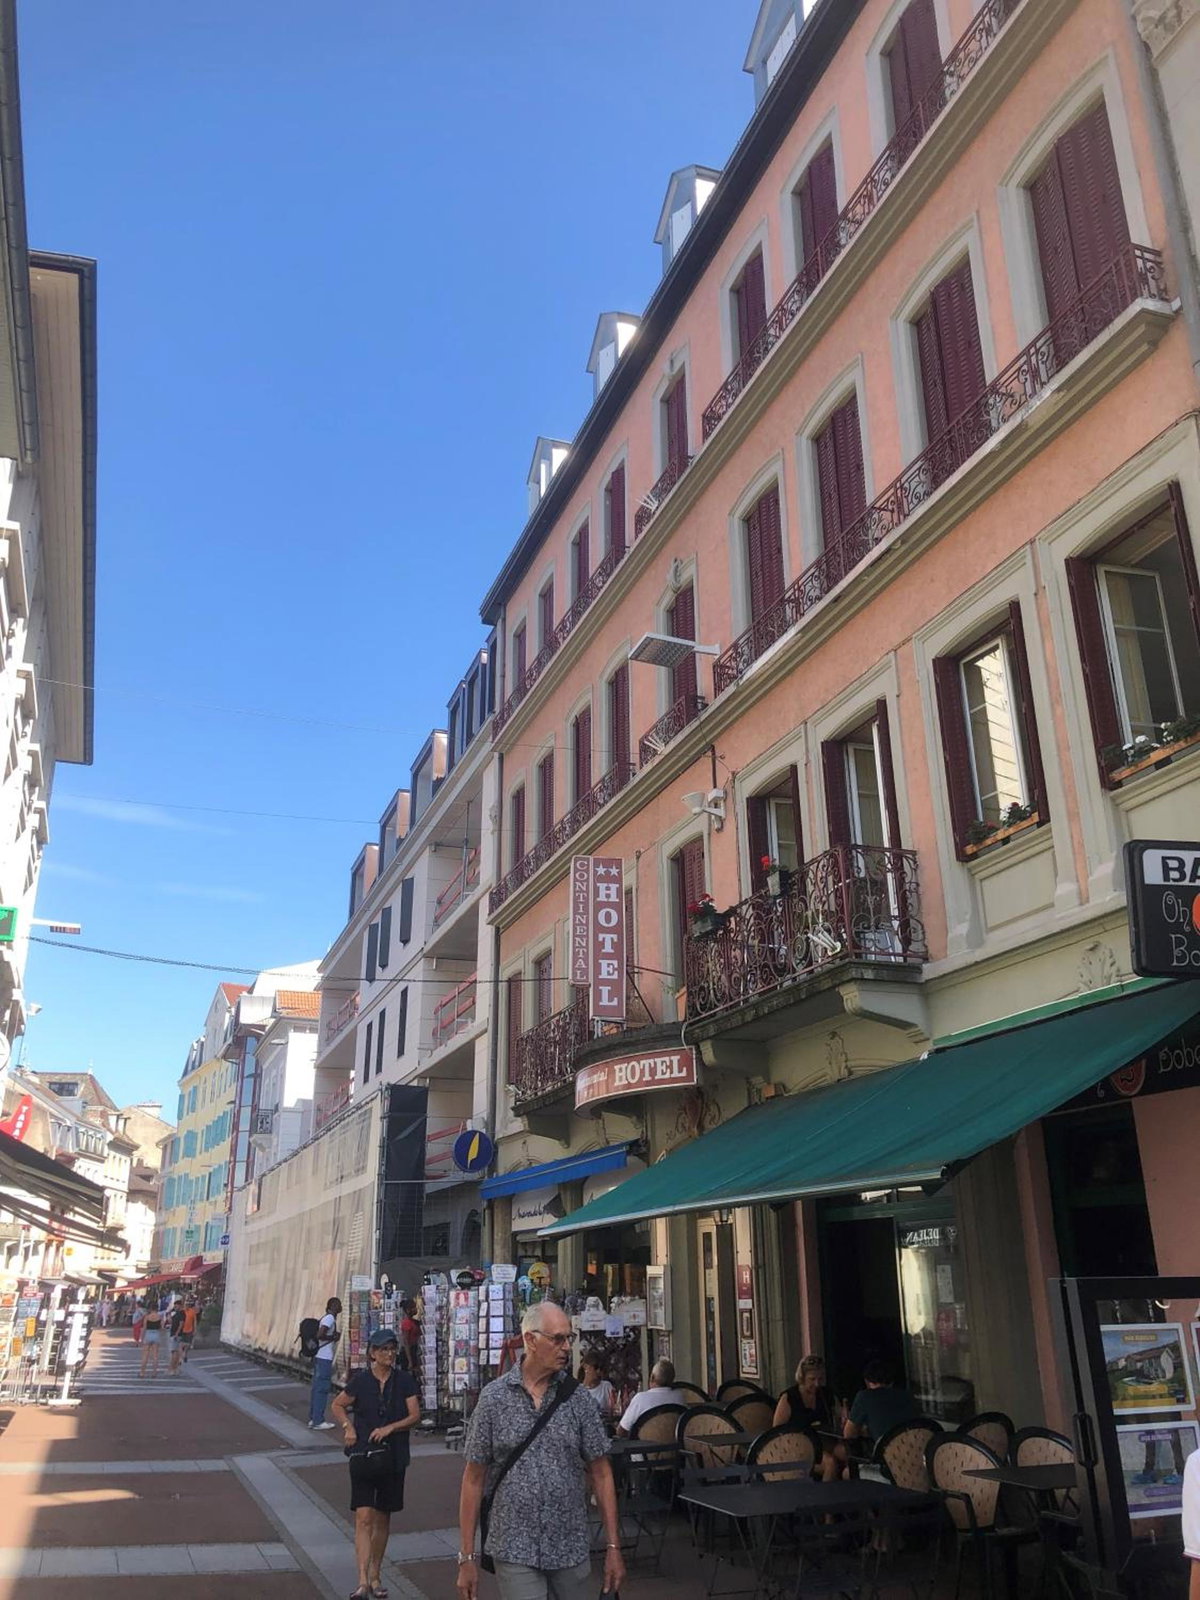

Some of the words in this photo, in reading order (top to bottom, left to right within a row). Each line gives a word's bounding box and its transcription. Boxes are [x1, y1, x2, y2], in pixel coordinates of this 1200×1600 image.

[574, 860, 588, 980] CONTINENTAL
[596, 883, 620, 1006] HOTEL
[614, 1056, 687, 1086] HOTEL
